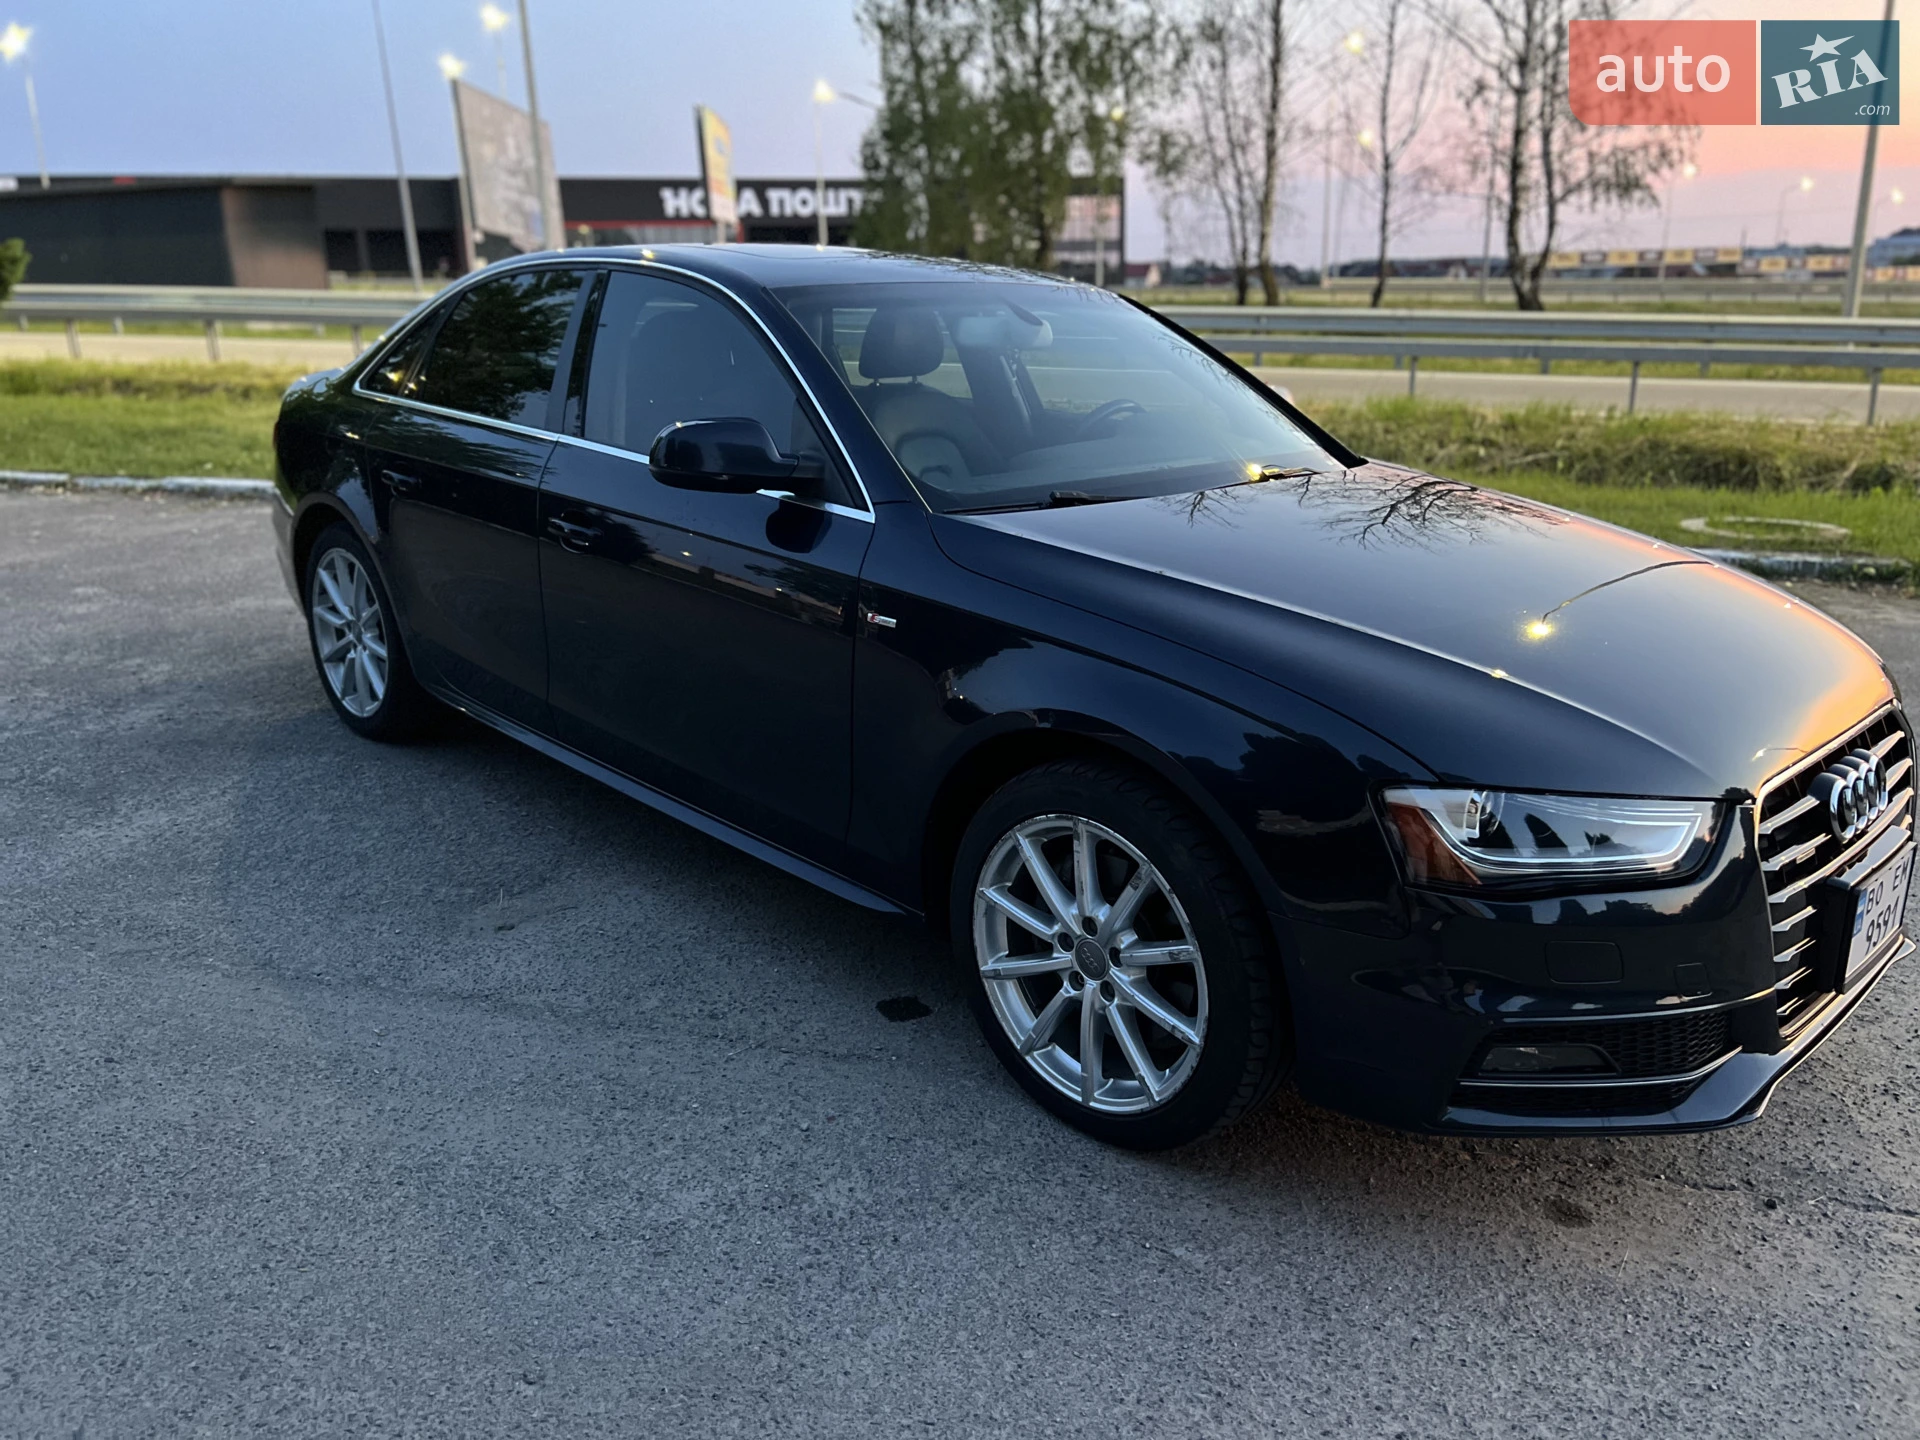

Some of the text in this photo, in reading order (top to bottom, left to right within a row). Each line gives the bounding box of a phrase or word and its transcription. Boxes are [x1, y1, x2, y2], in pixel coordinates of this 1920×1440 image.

[660, 186, 763, 218] НОА
[1866, 880, 1884, 915] BO
[1865, 896, 1900, 957] 9591
